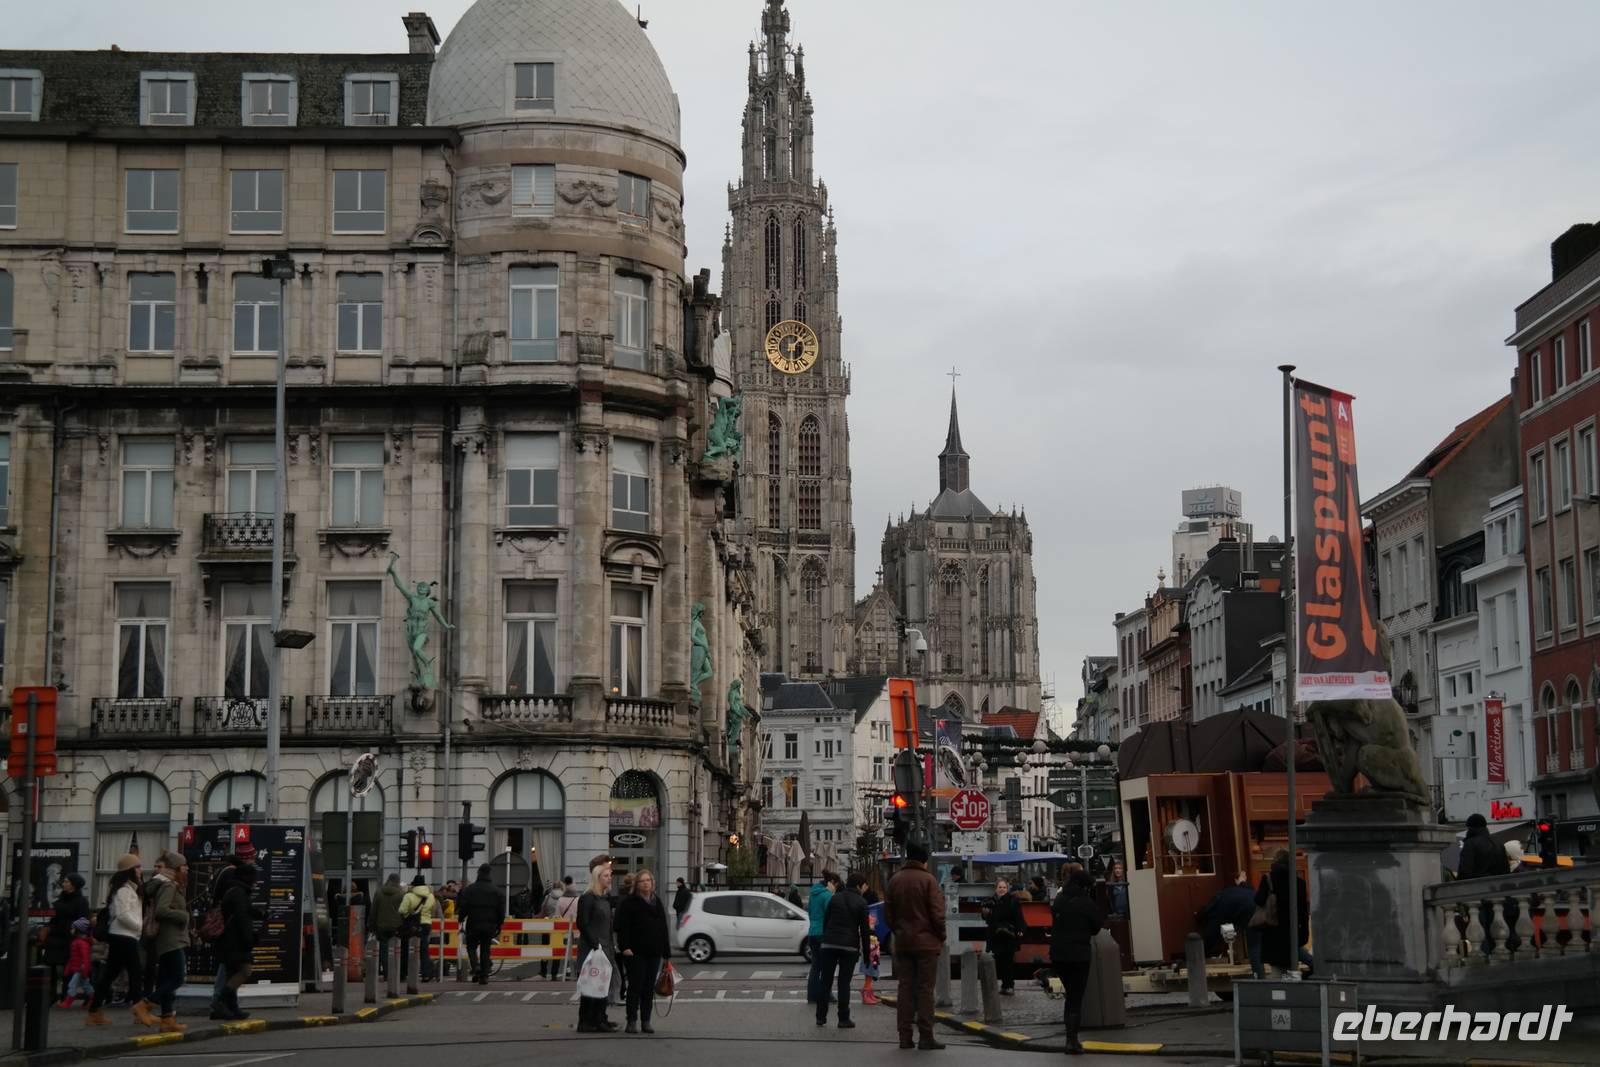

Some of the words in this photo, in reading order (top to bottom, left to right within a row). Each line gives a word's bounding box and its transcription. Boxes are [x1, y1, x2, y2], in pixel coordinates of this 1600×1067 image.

[1338, 400, 1348, 422] A
[1300, 393, 1346, 660] Glaspunt
[1488, 718, 1504, 777] Maritime
[951, 801, 987, 818] STOP
[238, 829, 246, 839] A
[1276, 1015, 1286, 1026] A
